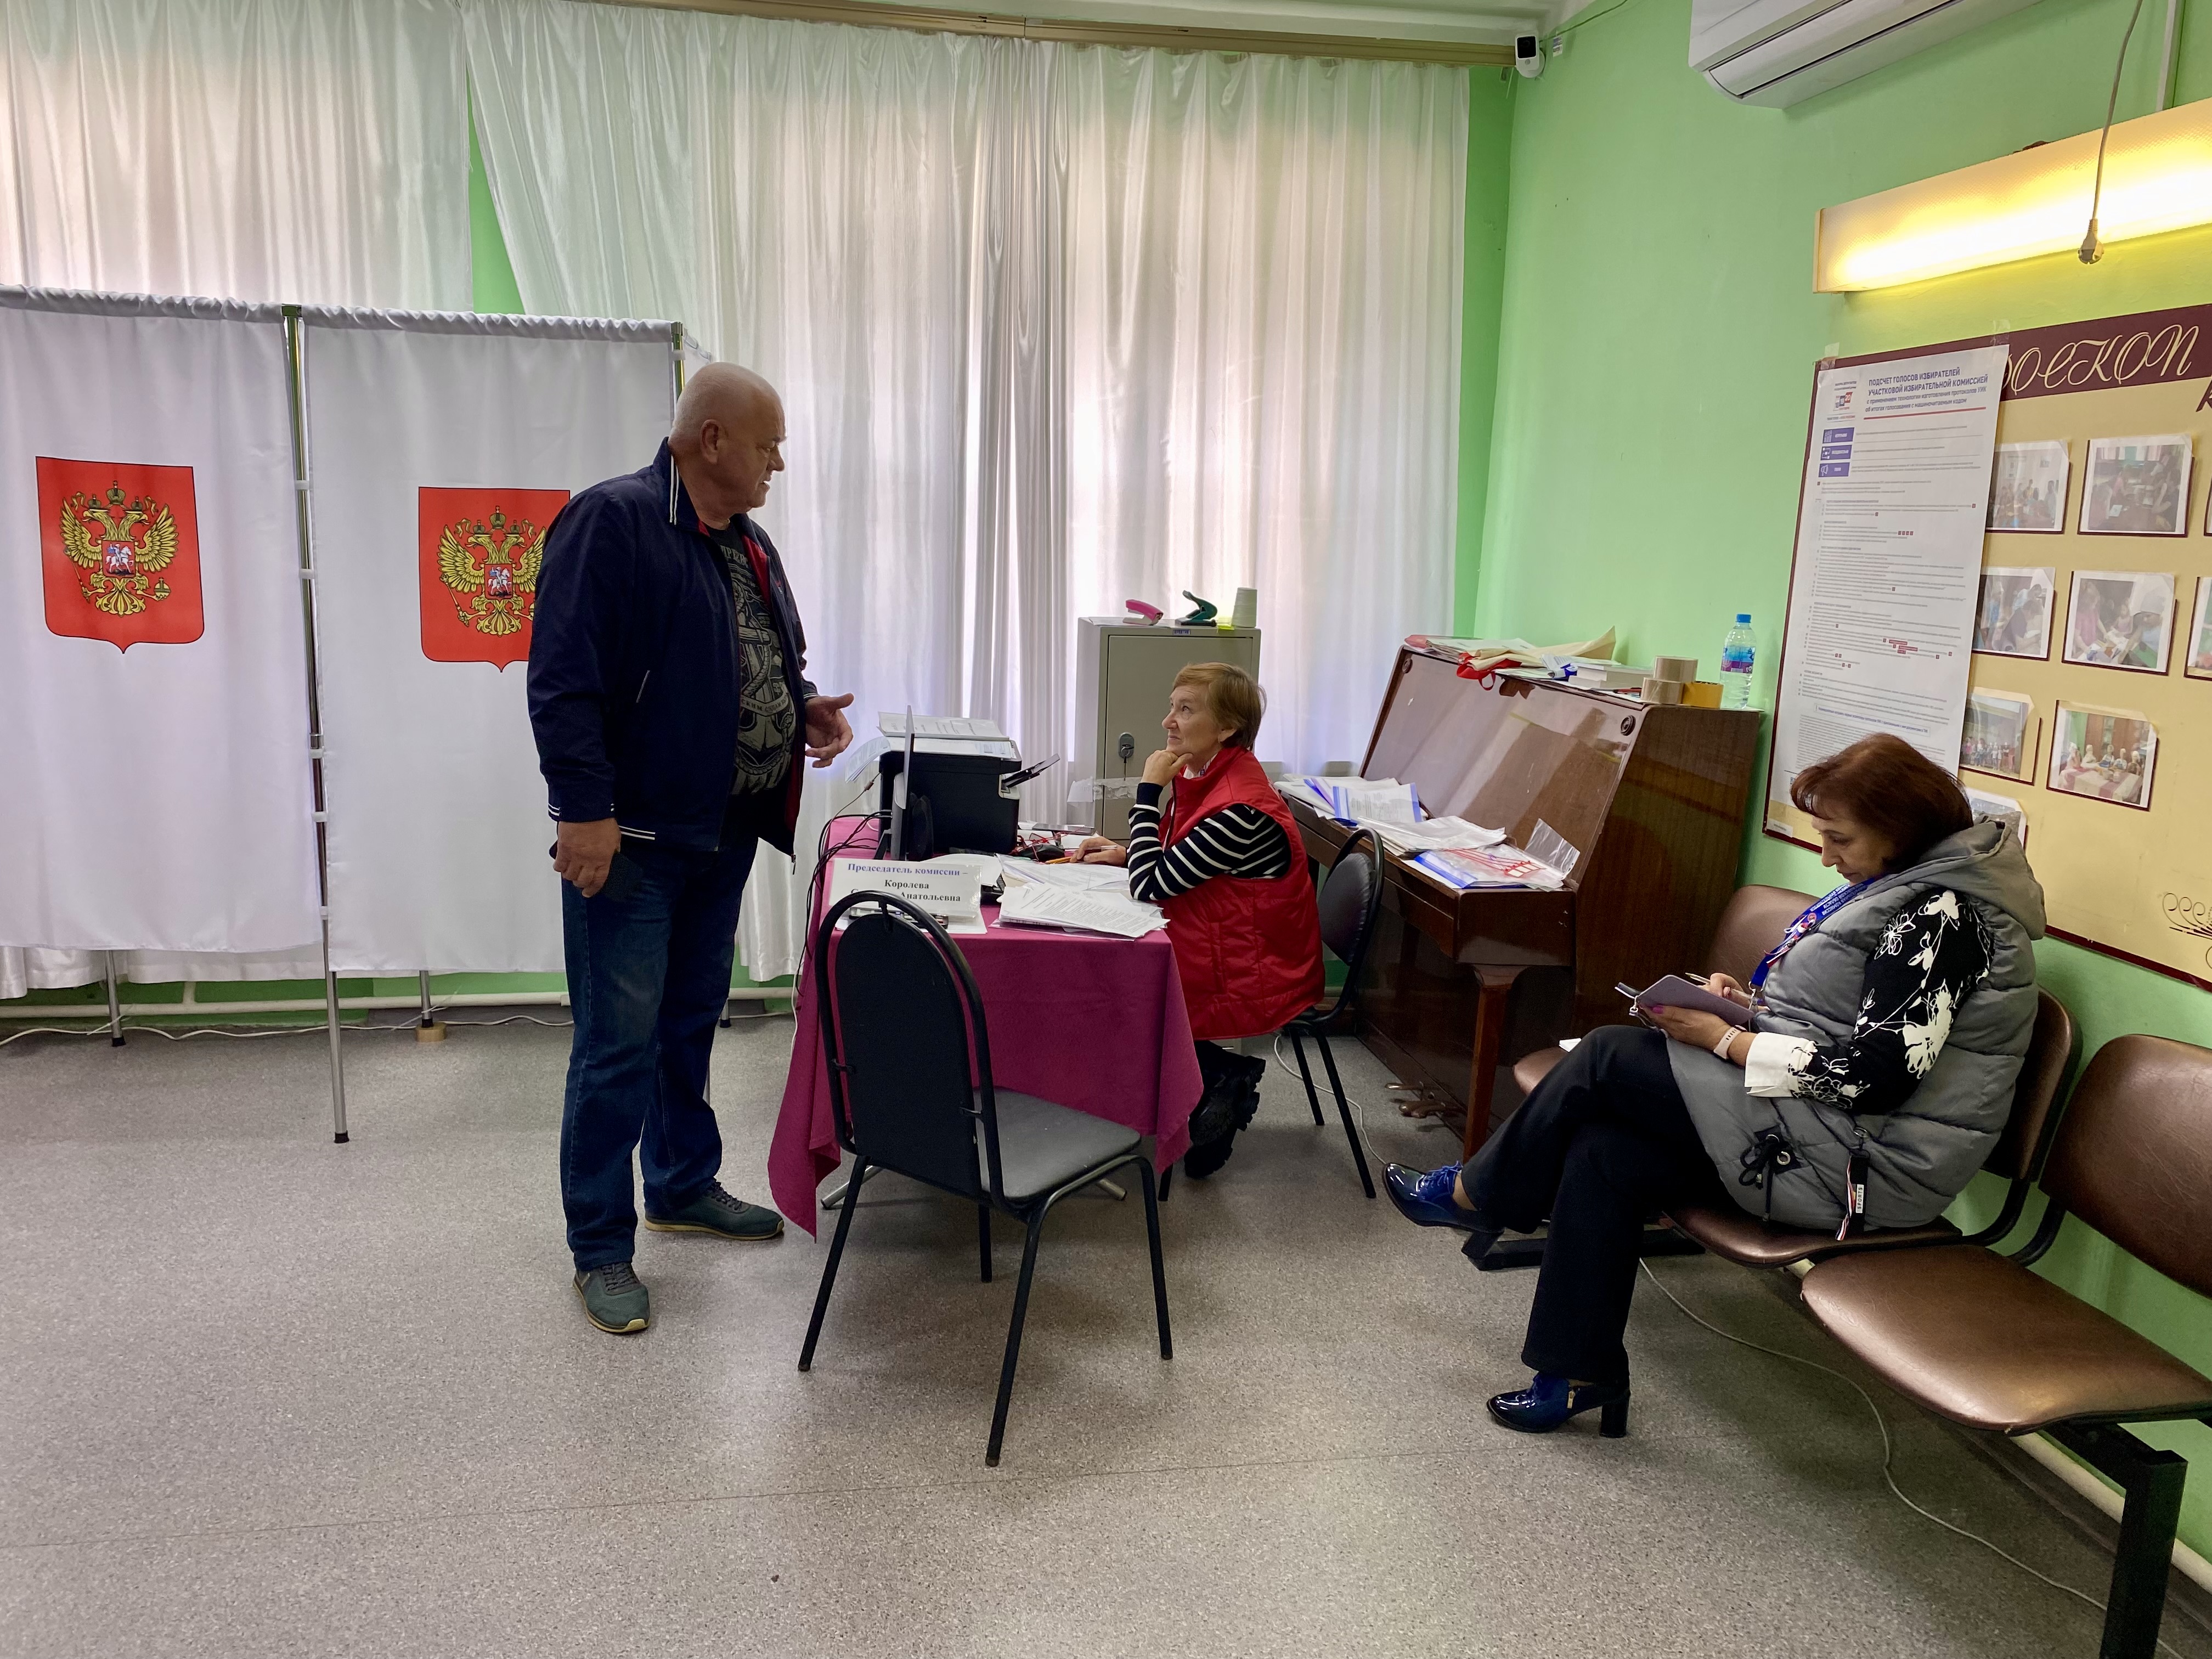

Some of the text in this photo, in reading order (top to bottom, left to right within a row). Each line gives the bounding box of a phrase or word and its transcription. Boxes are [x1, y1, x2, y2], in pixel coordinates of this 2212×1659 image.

[1869, 377, 1893, 386] ПОДСЧЕТ
[1893, 374, 1918, 383] ГОЛОСОВ
[1919, 366, 1960, 380] ИЗБИРАТЕЛЕЙ
[1868, 374, 1988, 396] УЧАСТКОВОЙ ИЗБИРАТЕЛЬНОЙ КОМИССИЕЙ
[848, 863, 912, 874] Председатель
[915, 868, 960, 876] комиссии
[884, 879, 929, 889] Королева
